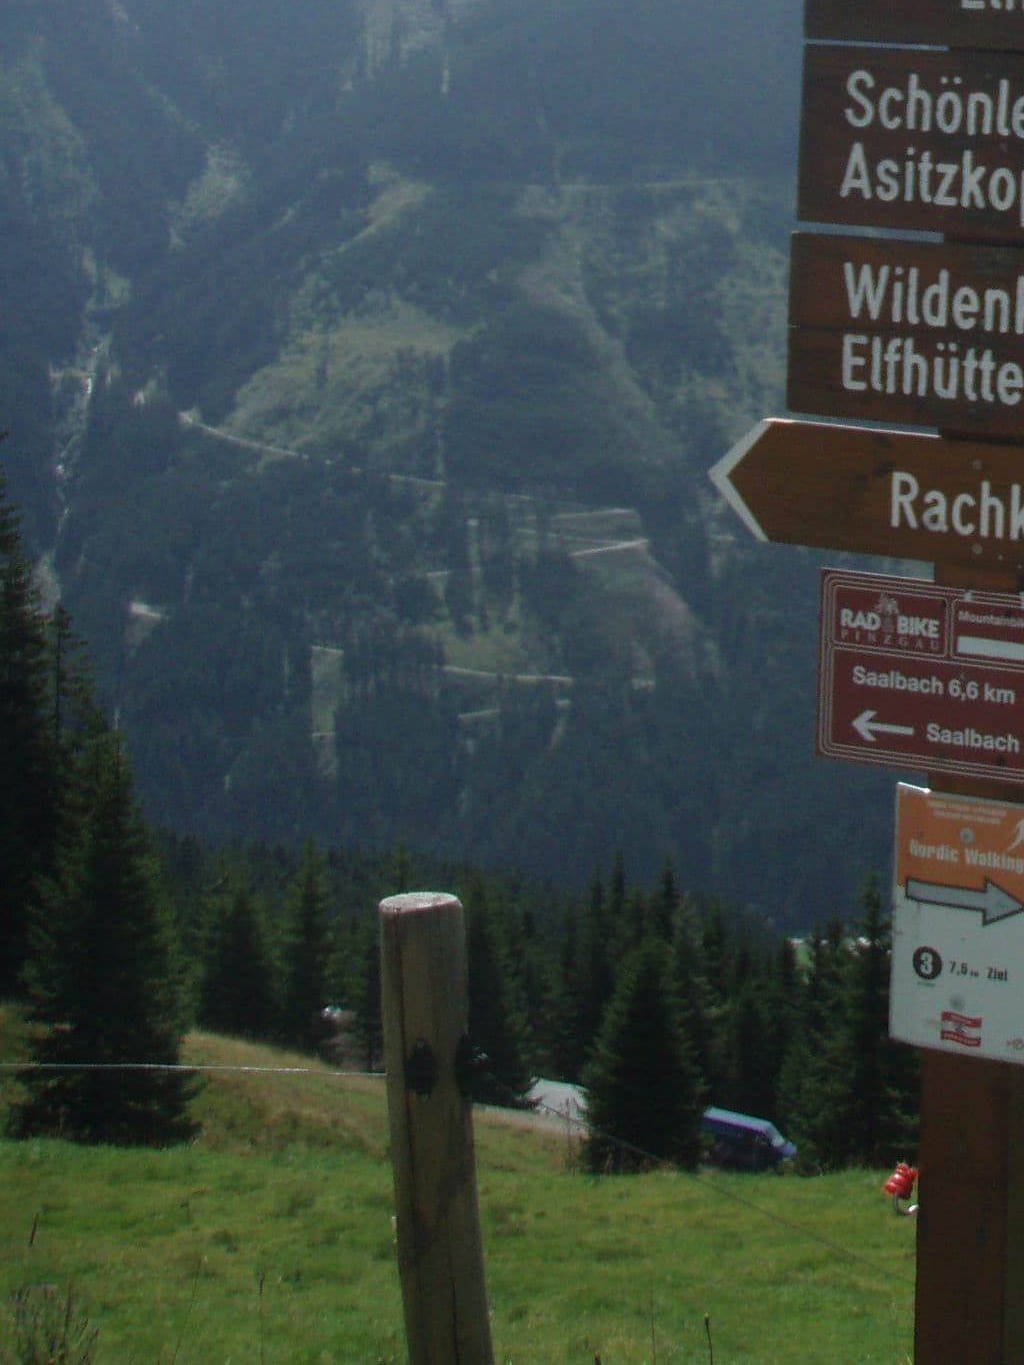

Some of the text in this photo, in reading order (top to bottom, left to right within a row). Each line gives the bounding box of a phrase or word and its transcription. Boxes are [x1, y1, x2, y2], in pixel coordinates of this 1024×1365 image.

[840, 608, 939, 639] RAD BIKE
[852, 665, 1016, 705] Saalbach 6,6 km
[926, 723, 1019, 754] Saalbach
[909, 839, 1024, 875] Nordic Walking
[919, 951, 934, 976] 3
